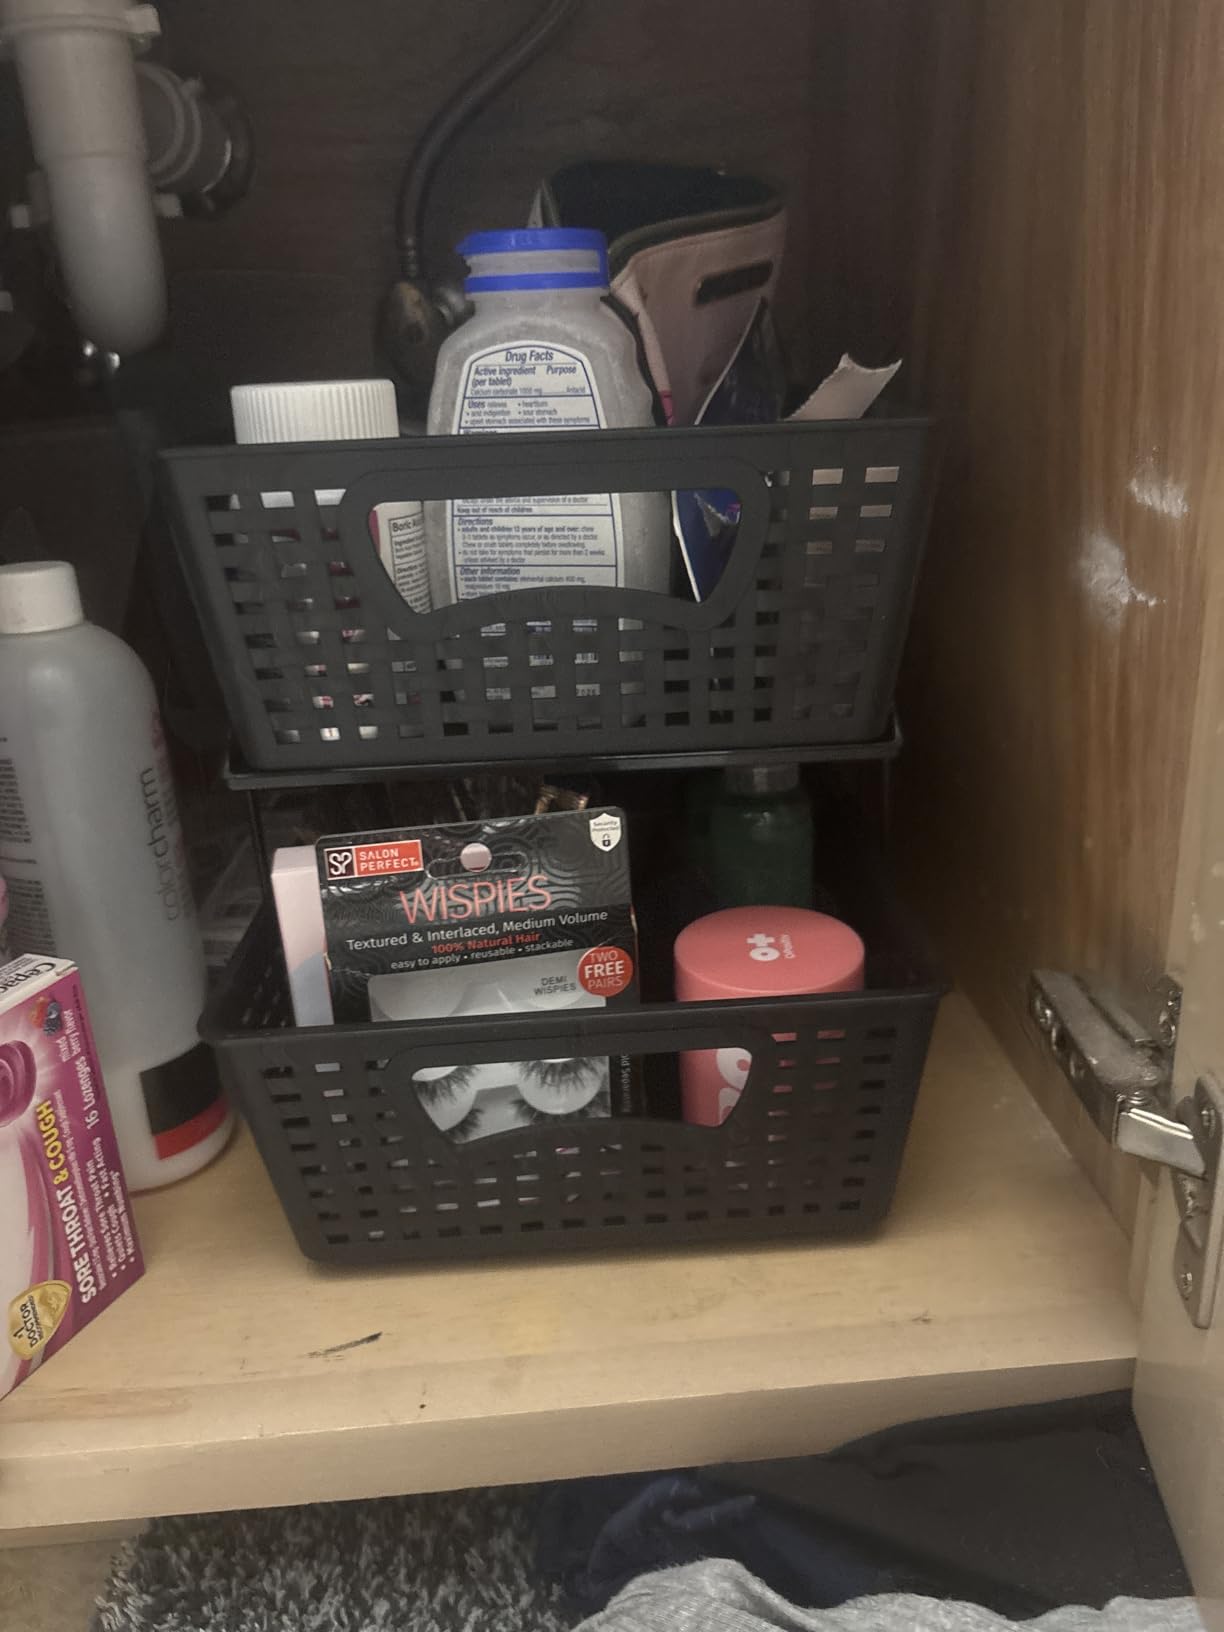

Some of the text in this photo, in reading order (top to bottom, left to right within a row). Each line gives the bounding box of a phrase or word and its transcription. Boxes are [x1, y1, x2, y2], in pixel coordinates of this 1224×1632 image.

[505, 350, 554, 364] Drug Facts
[474, 366, 497, 376] Active
[546, 365, 577, 376] Purpose
[472, 377, 512, 388] (per tablet)
[468, 400, 486, 409] Uses
[392, 520, 411, 532] Boric
[458, 518, 494, 526] Directions
[460, 567, 520, 576] Other information
[359, 848, 400, 861] SALON
[360, 857, 416, 872] PERFECT
[399, 874, 552, 924] WISPIES
[346, 910, 608, 951] Textured & Interlaced, Medium Volume
[432, 932, 541, 954] 100% Natural Hair
[390, 938, 574, 972] easy to apply reusable stackable
[588, 950, 618, 962] TWO
[584, 961, 625, 979] FREE
[534, 982, 577, 996] WISPIES
[541, 976, 568, 987] DEMI
[587, 976, 624, 990] PAIRS
[56, 1035, 72, 1063] mixed
[76, 1055, 96, 1112] Lozenges
[84, 1110, 100, 1130] 16
[36, 1100, 66, 1172] COUGH
[86, 1159, 97, 1182] Pain
[92, 1136, 110, 1190] Fast Acting
[52, 1172, 70, 1185] &
[90, 1181, 104, 1213] Throat
[56, 1185, 87, 1258] THROAT
[98, 1211, 110, 1234] Sore
[74, 1252, 98, 1304] SORE
[20, 1302, 39, 1348] DOCTOR
